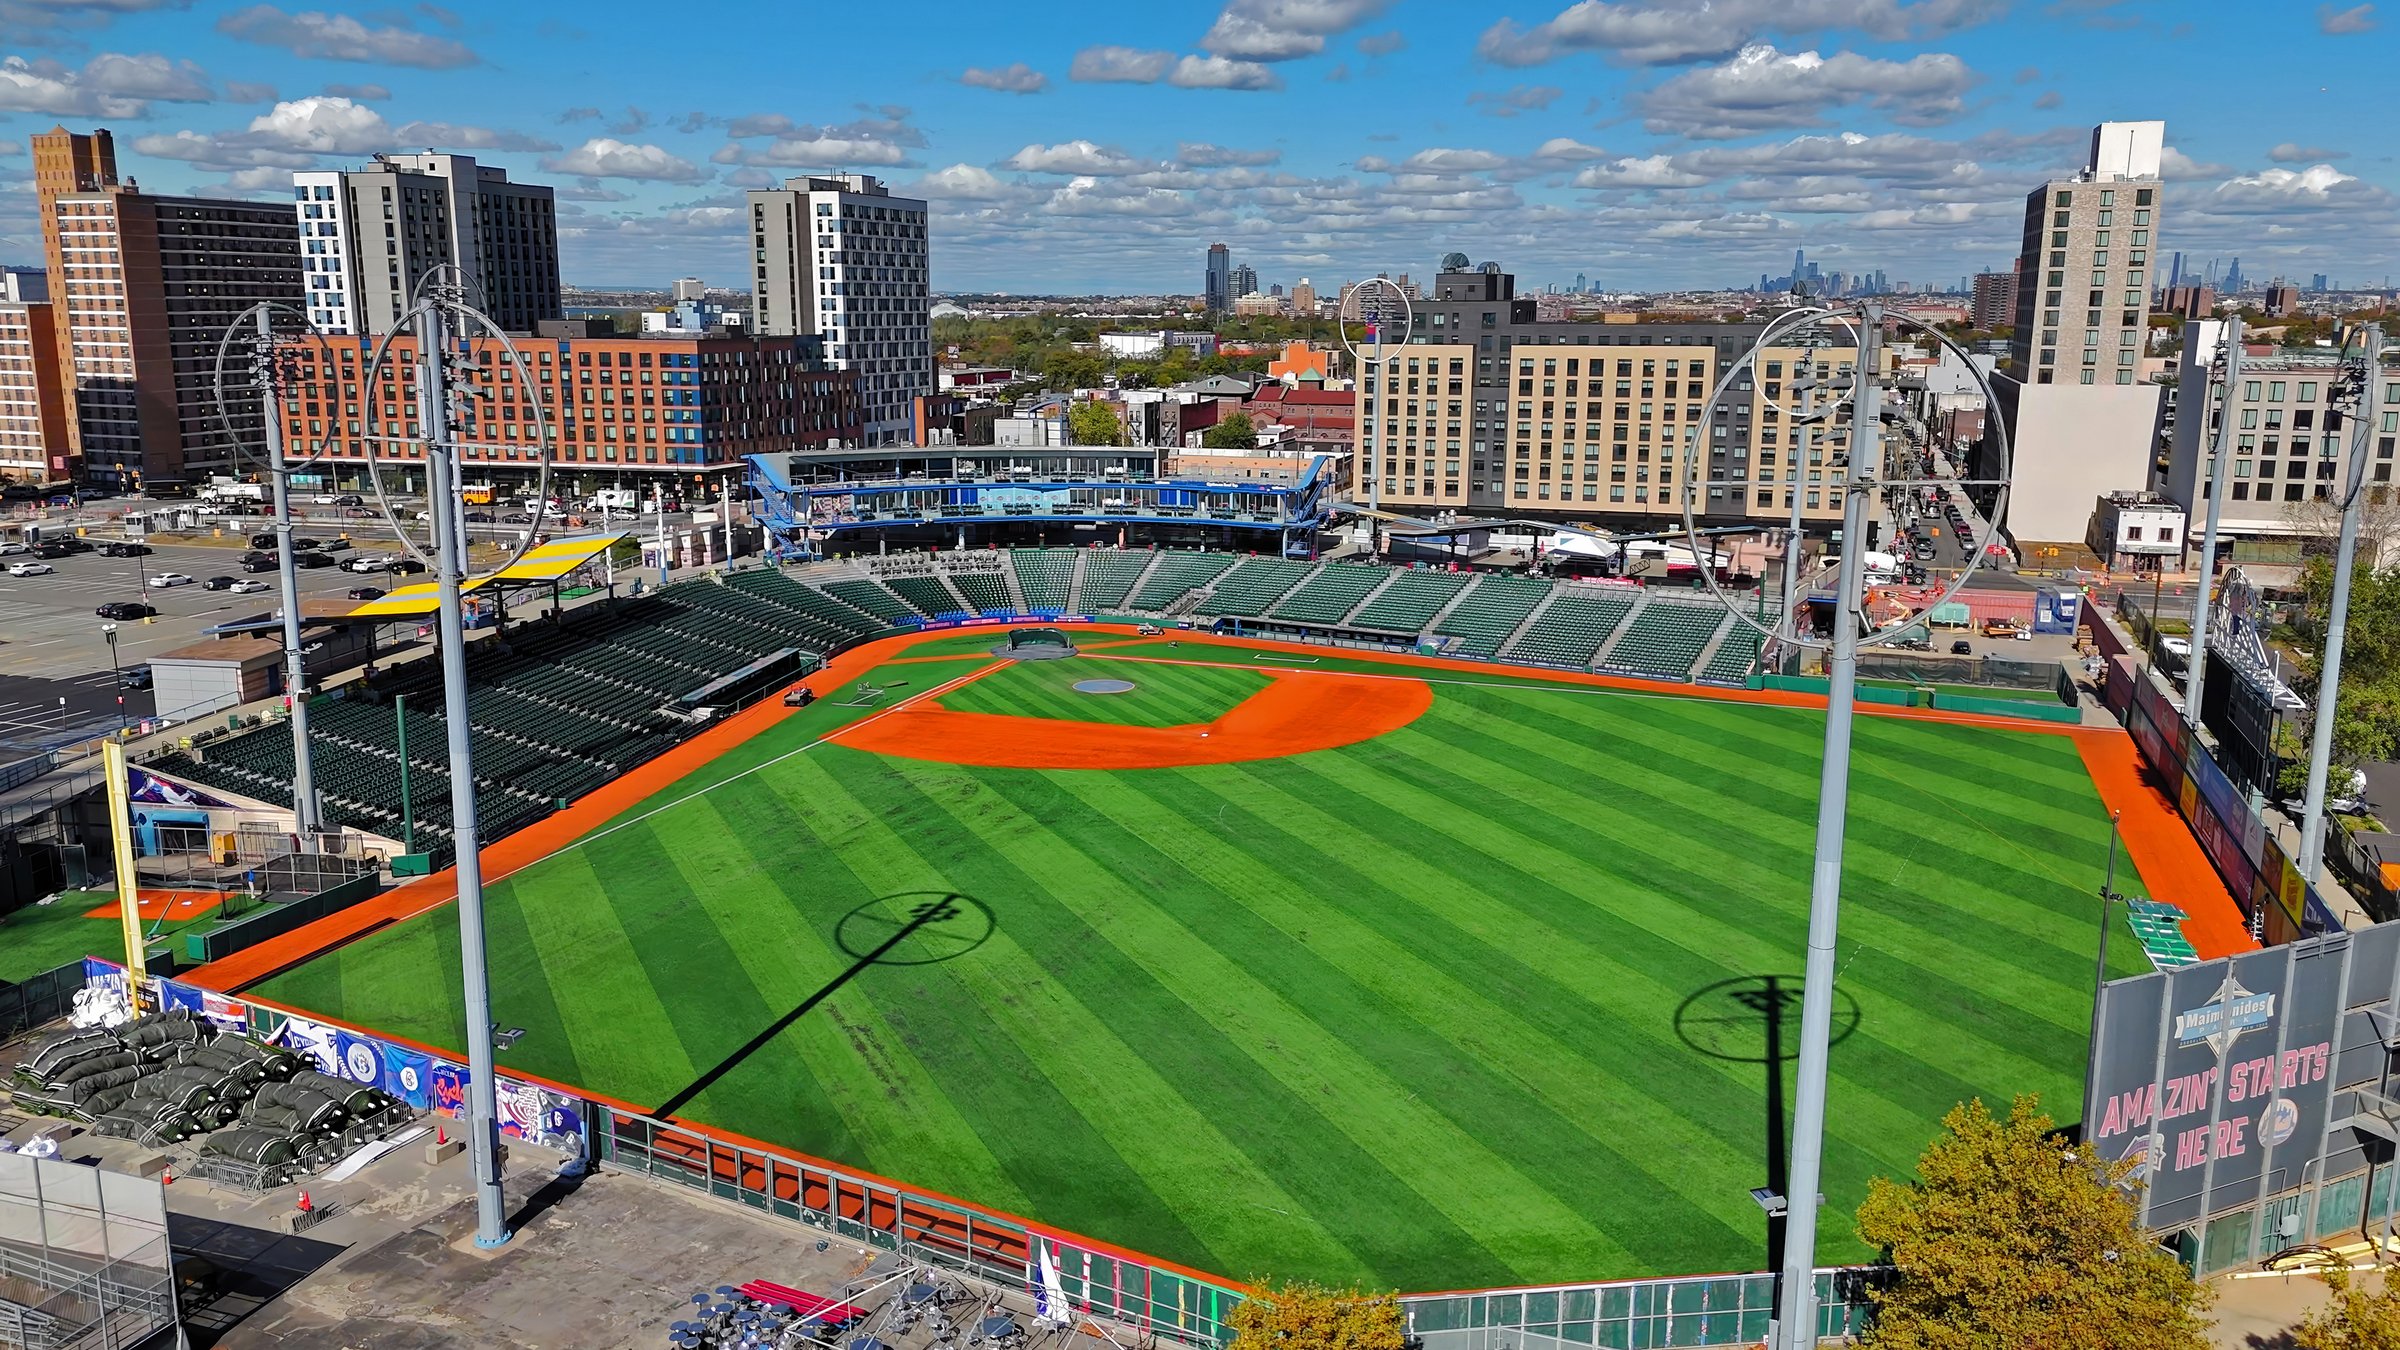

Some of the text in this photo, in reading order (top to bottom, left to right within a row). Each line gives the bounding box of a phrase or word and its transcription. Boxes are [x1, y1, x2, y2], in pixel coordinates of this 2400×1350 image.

[2186, 999, 2266, 1029] Maimnides
[2227, 1041, 2330, 1103] STARTS
[2174, 1115, 2249, 1172] HERE
